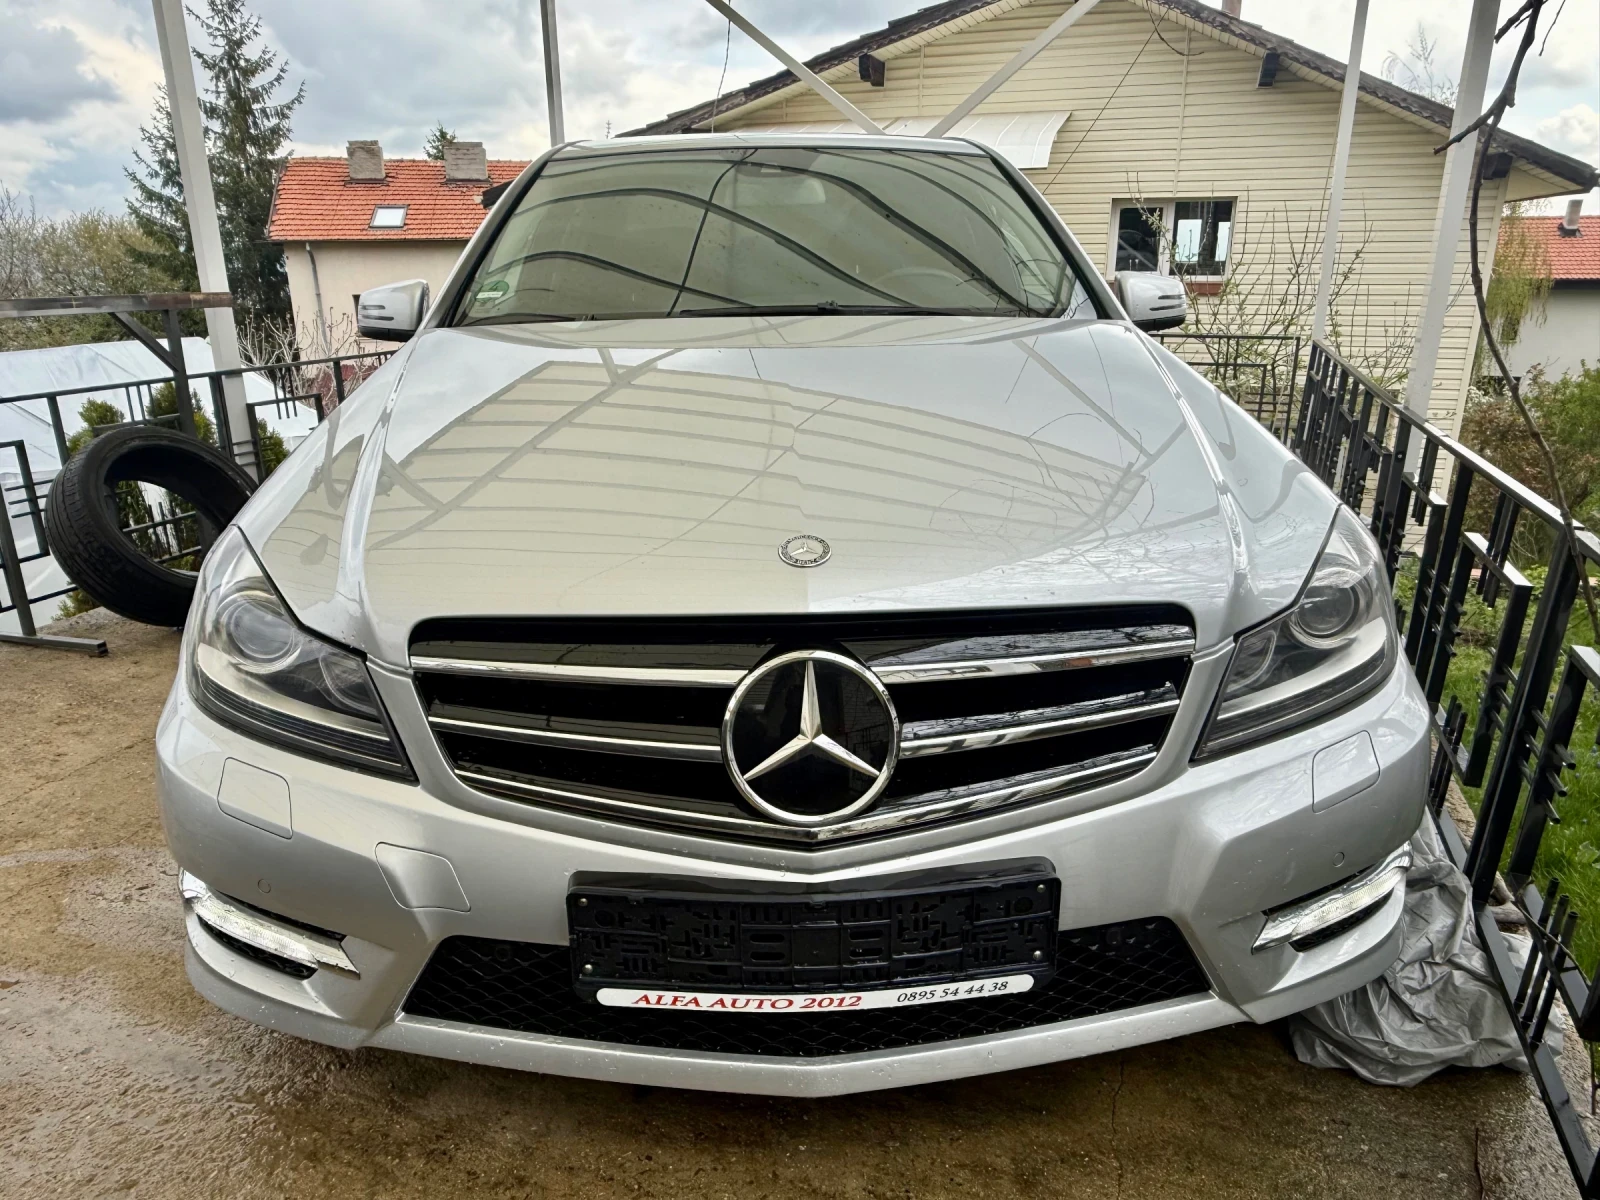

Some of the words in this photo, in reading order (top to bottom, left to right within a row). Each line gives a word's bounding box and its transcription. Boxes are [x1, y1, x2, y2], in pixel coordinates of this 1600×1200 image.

[897, 989, 936, 1003] 0895
[939, 987, 960, 998] 54
[964, 984, 985, 995] 44
[988, 981, 1009, 992] 38
[631, 994, 702, 1008] ALFA
[706, 997, 794, 1010] AUTO
[799, 996, 862, 1009] 2012
